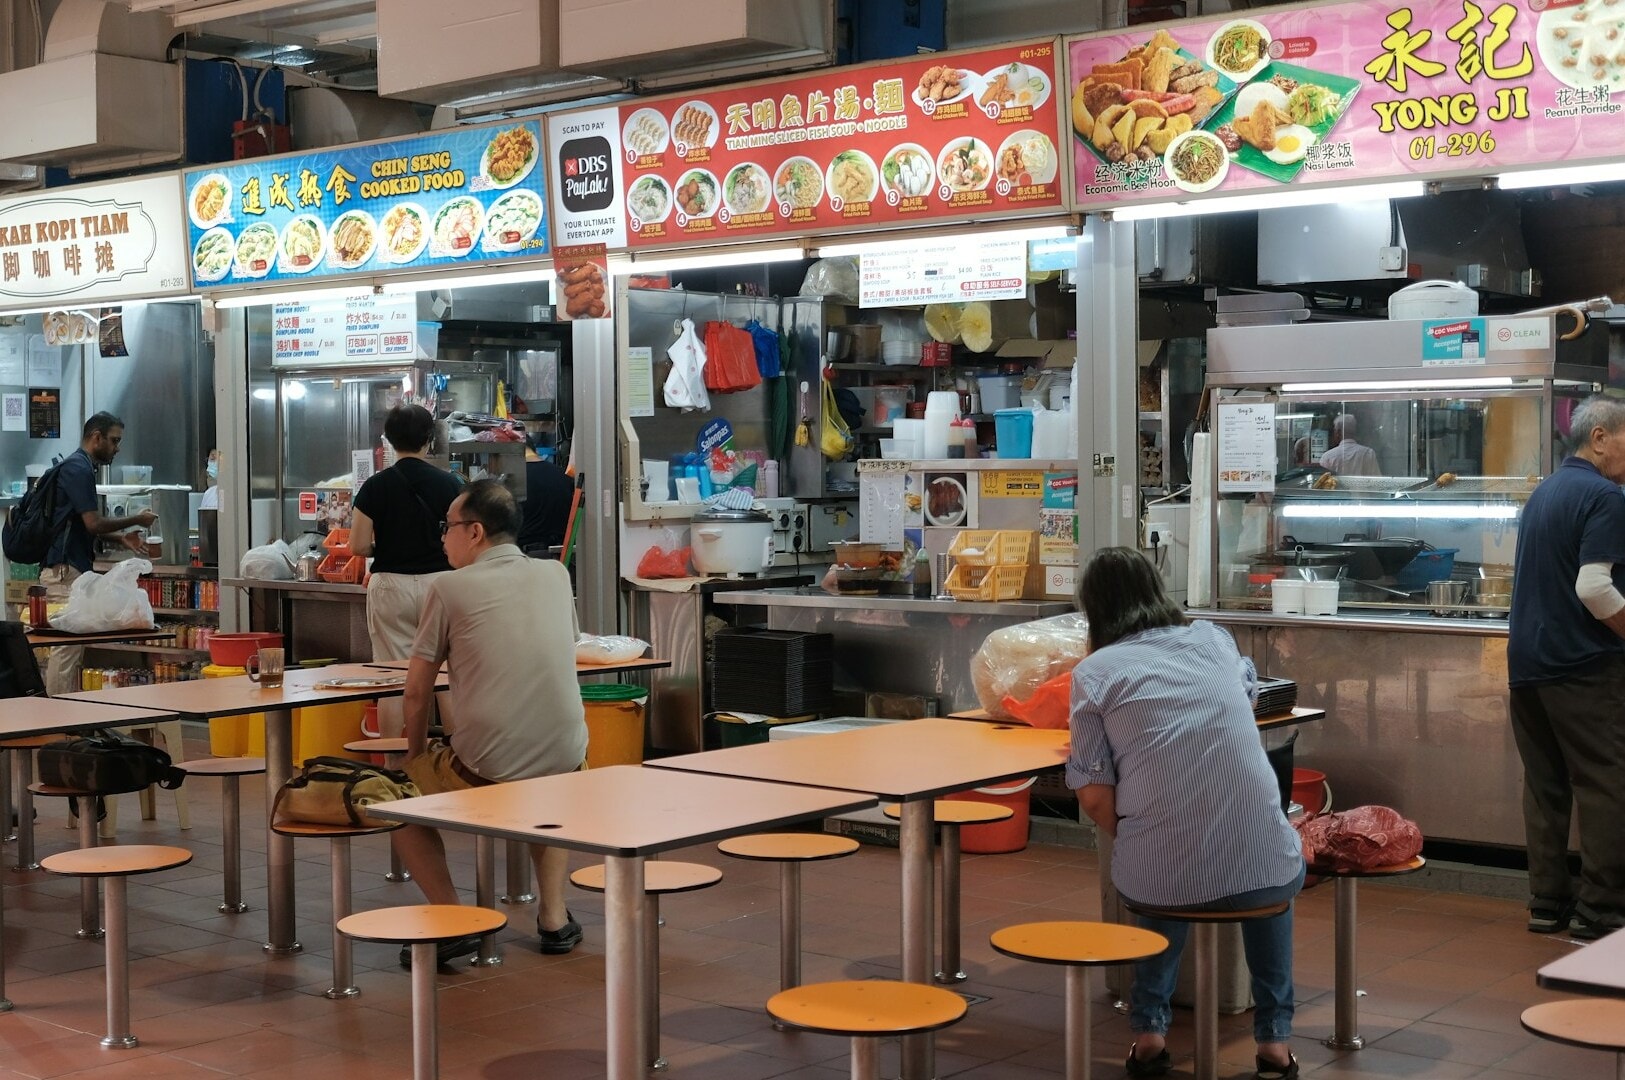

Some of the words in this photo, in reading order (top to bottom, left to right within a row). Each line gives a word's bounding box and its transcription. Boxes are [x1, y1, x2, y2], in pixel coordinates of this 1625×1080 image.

[1364, 0, 1534, 92] 永記
[1020, 47, 1051, 59] #01-295
[1556, 84, 1609, 106] 花生粥
[923, 99, 934, 112] 12
[987, 102, 999, 117] 11
[1372, 92, 1478, 133] YONG
[1487, 86, 1529, 121] JI
[1545, 107, 1578, 118] Peanut
[1581, 102, 1622, 116] Porridge
[562, 125, 580, 134] SCAN
[582, 124, 590, 132] TO
[592, 122, 604, 130] PAY
[727, 138, 749, 150] TIAN
[749, 135, 776, 149] MING
[776, 130, 807, 145] SLICED
[808, 126, 830, 141] FISH
[830, 123, 856, 138] SOUP
[864, 115, 907, 133] NOODLE
[678, 145, 685, 154] 2
[1409, 130, 1496, 160] 01-296
[629, 151, 635, 161] 1
[1305, 142, 1352, 163] 椰浆饭
[371, 157, 408, 178] CHIN
[411, 151, 451, 172] SENG
[578, 155, 607, 175] DBS
[1304, 160, 1326, 171] Nasi
[1327, 157, 1354, 169] Lemak
[1095, 159, 1163, 184] 经济米粉
[360, 175, 421, 199] COOKED
[423, 170, 465, 191] FOOD
[566, 174, 608, 200] PayLah!
[998, 183, 1008, 194] 10
[1085, 182, 1129, 195] Economic
[1131, 180, 1148, 190] Bee
[1150, 177, 1176, 188] Hoon
[890, 192, 896, 203] 8
[942, 187, 949, 198] 9
[782, 204, 788, 214] 6
[834, 198, 840, 209] 7
[678, 215, 685, 224] 4
[722, 210, 728, 220] 5
[0, 224, 32, 247] KAH
[36, 218, 77, 243] KOPI
[81, 212, 129, 238] TIAM
[564, 220, 582, 230] YOUR
[584, 217, 616, 228] ULTIMATE
[633, 219, 640, 229] 3
[567, 229, 600, 240] EVERYDAY
[602, 227, 614, 236] APP
[520, 240, 544, 250] 01-294
[160, 278, 184, 288] #01-293
[990, 280, 1019, 288] SELF-SERVICE
[1446, 324, 1468, 333] Voucher
[1514, 330, 1541, 338] CLEAN
[384, 336, 408, 346] 自助服务
[1434, 338, 1460, 348] Accepted
[700, 425, 728, 452] Salonpas
[1052, 490, 1074, 498] Accepted
[852, 824, 886, 838] Heineken
